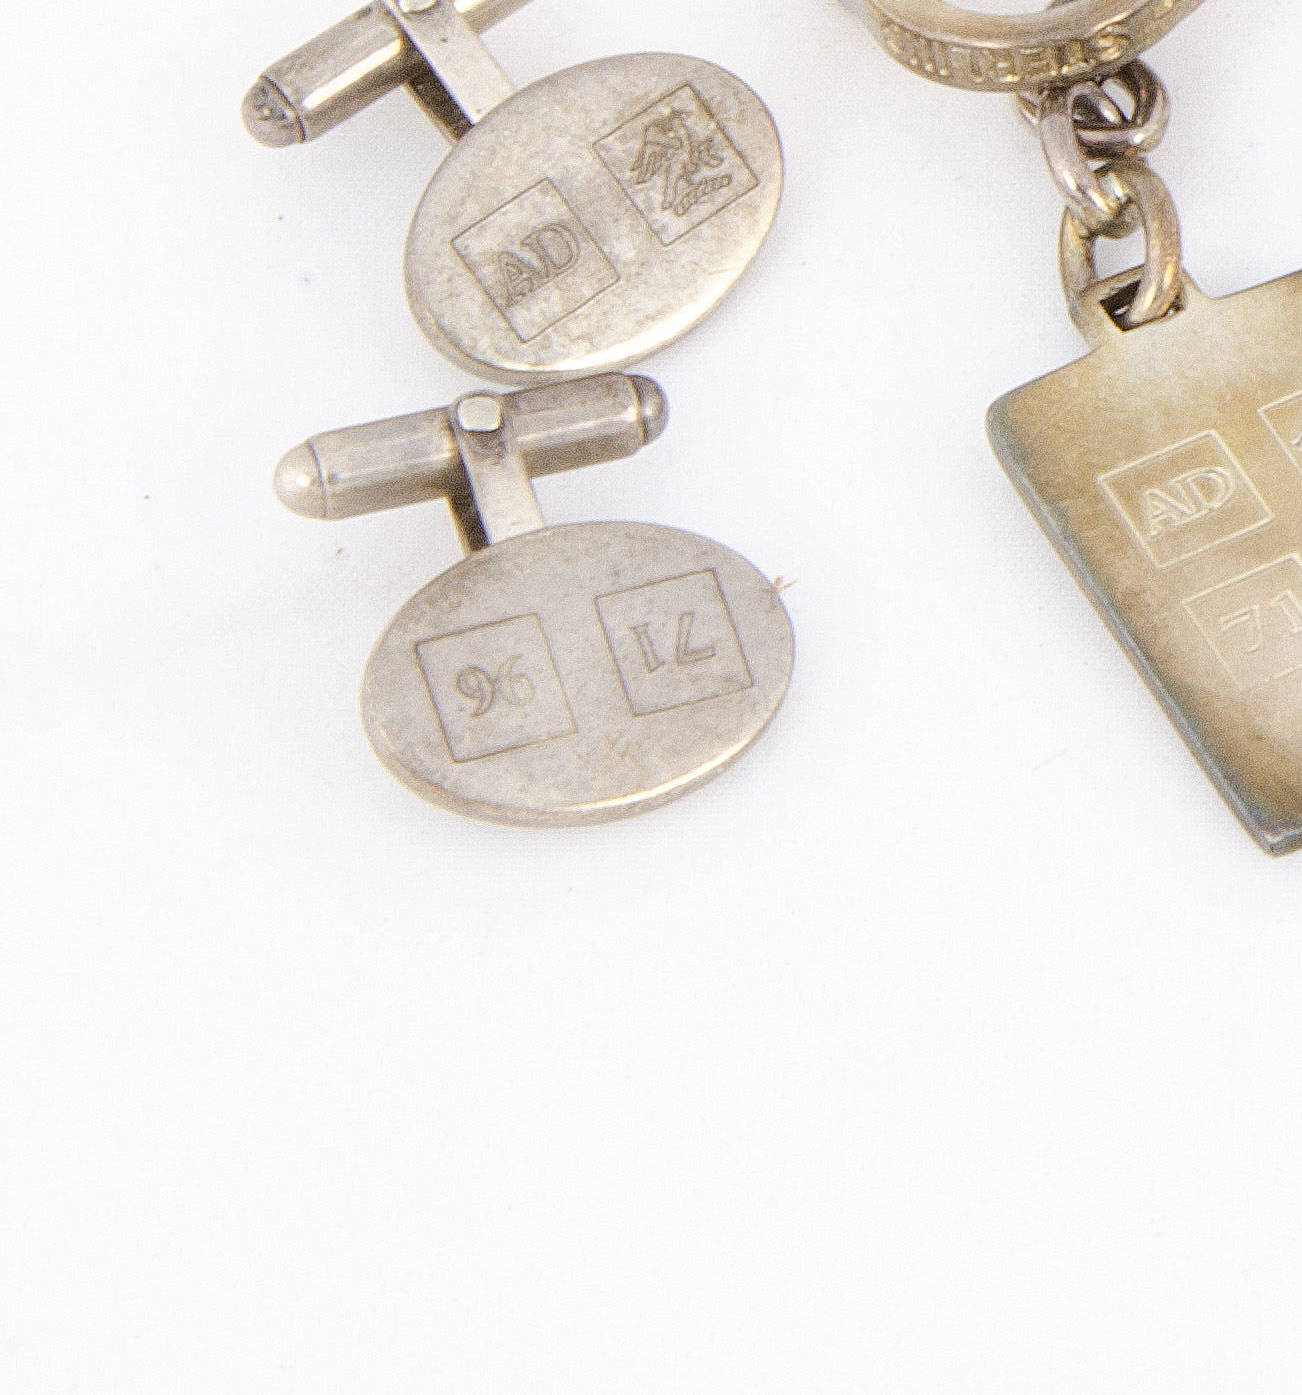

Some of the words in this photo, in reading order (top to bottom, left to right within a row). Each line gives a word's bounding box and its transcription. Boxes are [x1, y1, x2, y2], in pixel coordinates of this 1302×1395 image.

[880, 23, 1131, 84] STERLING
[494, 223, 584, 310] AD
[1139, 463, 1236, 536] AD
[630, 609, 718, 673] 71
[454, 652, 535, 720] 96
